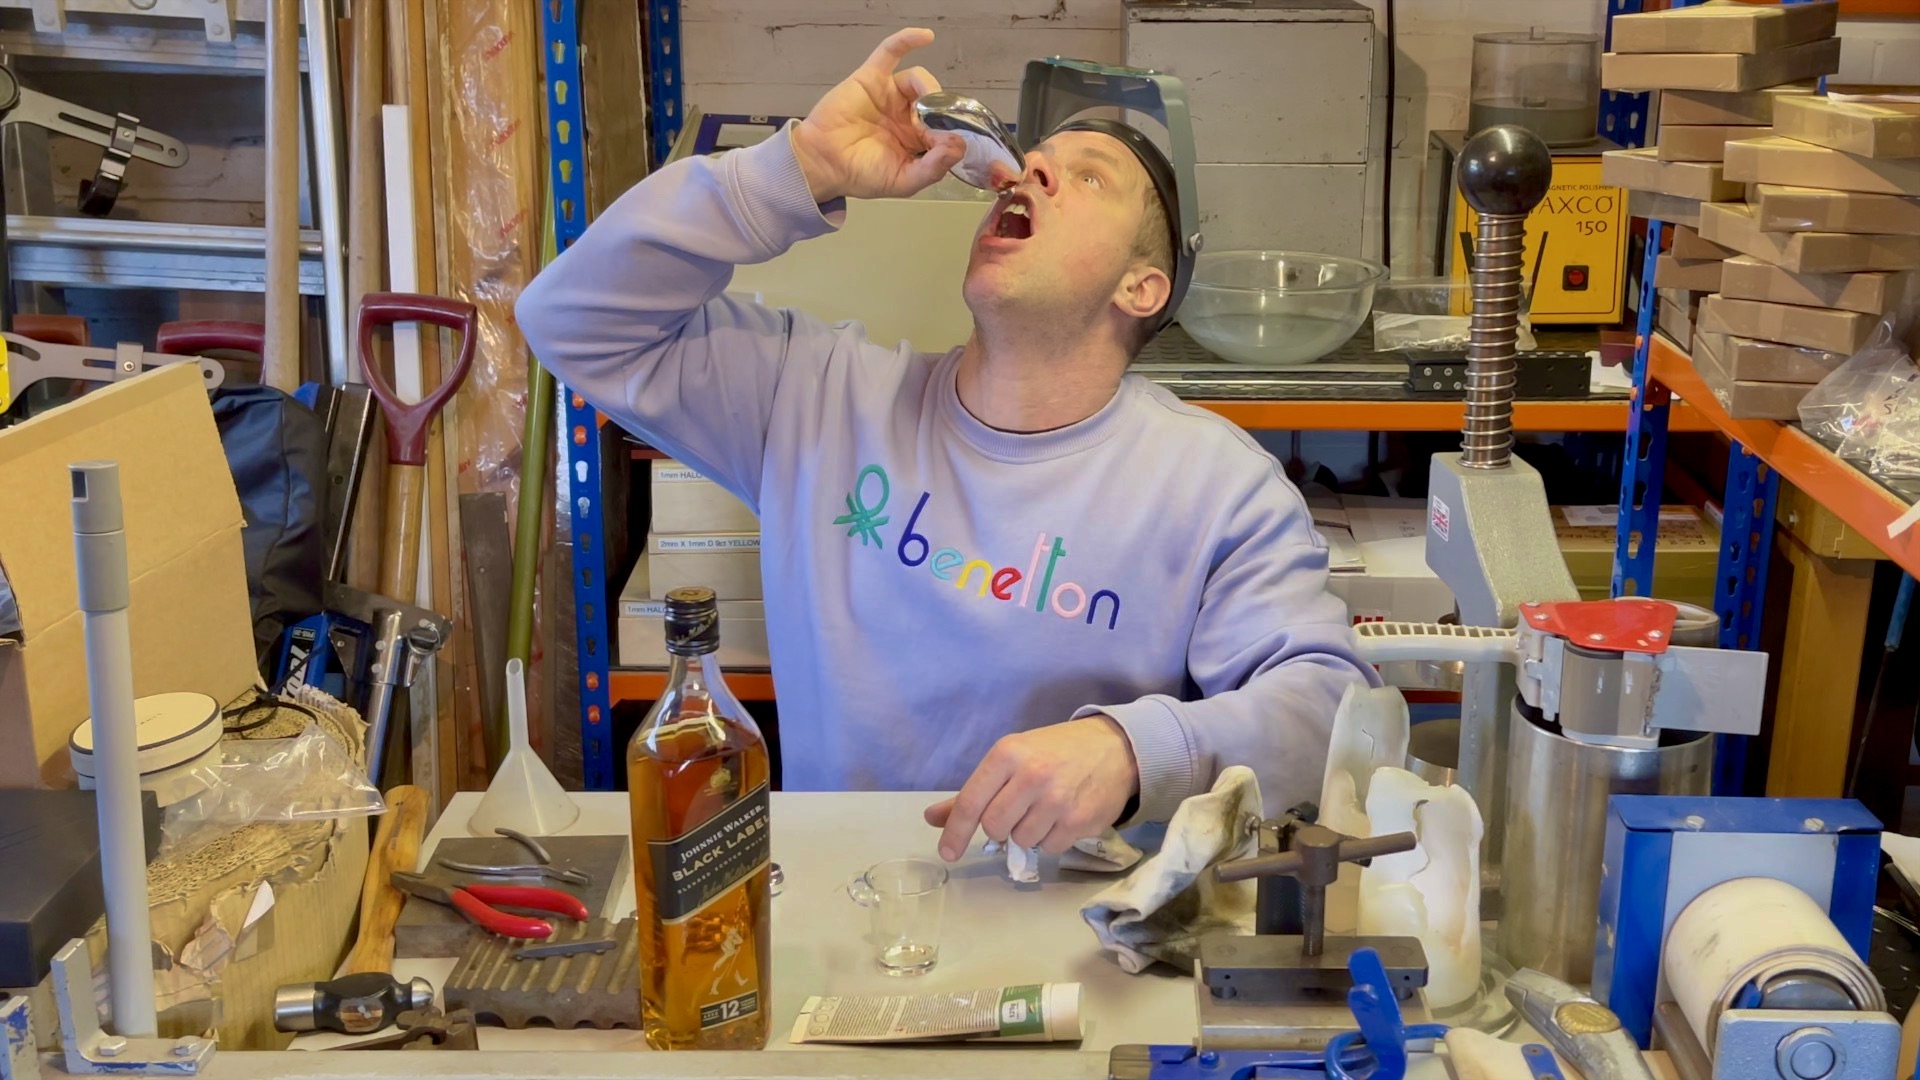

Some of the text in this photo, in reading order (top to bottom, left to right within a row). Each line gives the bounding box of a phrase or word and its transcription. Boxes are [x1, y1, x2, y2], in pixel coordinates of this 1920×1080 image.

[1530, 195, 1613, 215] AXCO
[1575, 220, 1608, 236] 150
[728, 539, 761, 548] YELLOW
[897, 491, 1120, 630] benetton
[672, 845, 724, 882] BLACK
[725, 814, 770, 849] LABEL
[680, 830, 724, 864] JOHNNIE
[720, 999, 741, 1020] 12
